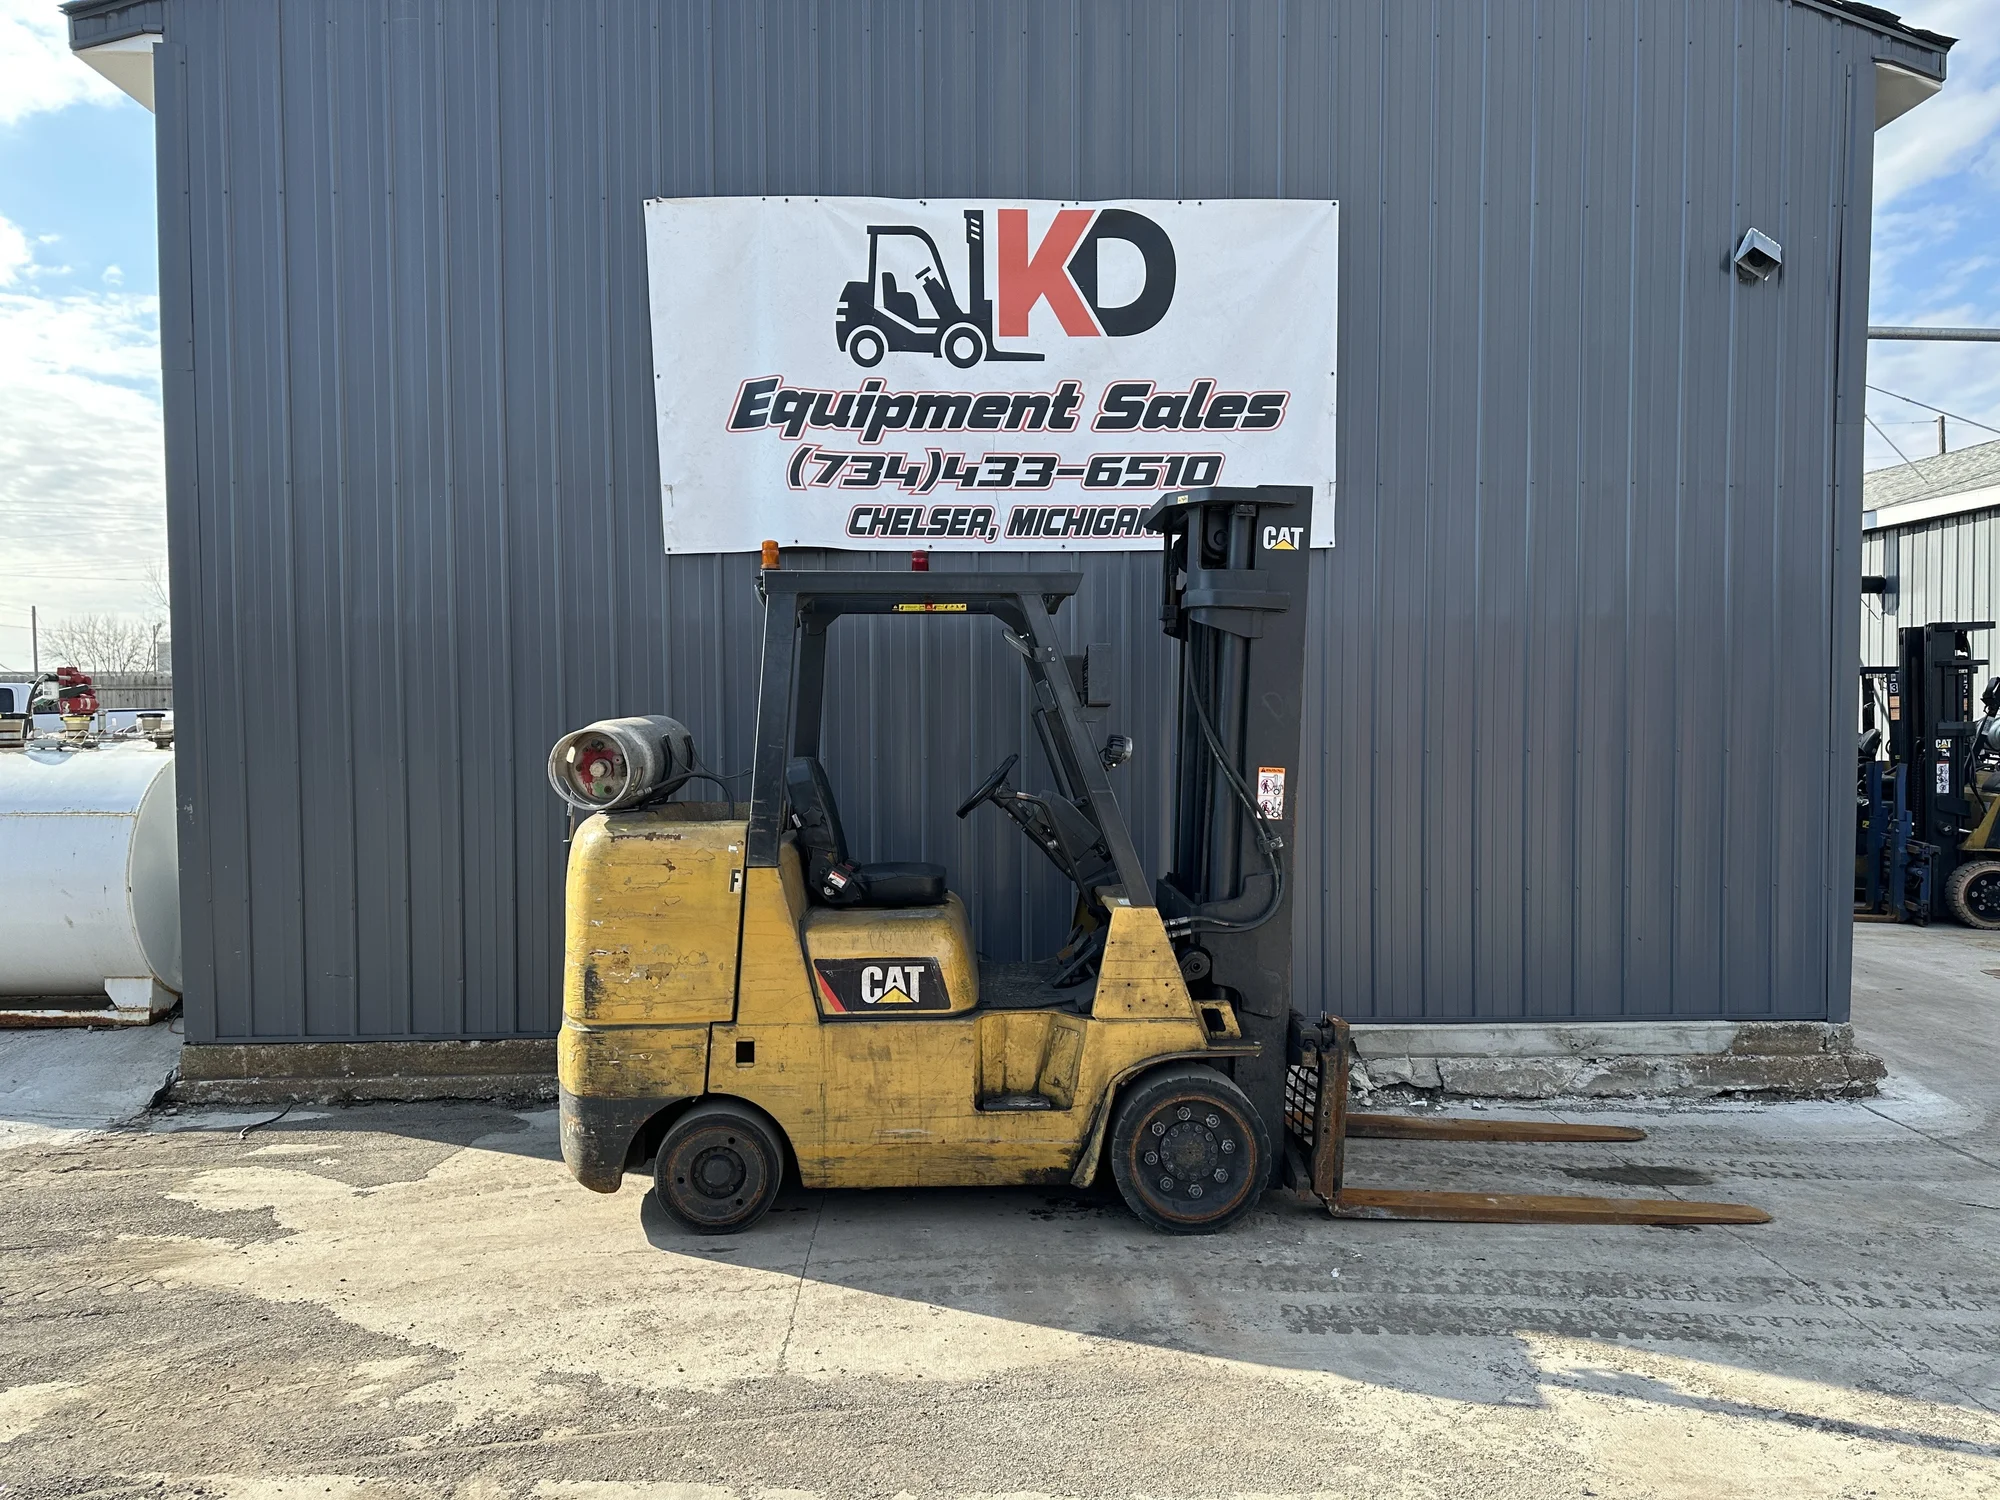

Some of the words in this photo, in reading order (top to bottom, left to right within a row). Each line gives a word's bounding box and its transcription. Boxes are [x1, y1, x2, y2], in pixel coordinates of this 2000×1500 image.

[998, 208, 1177, 337] KD
[730, 378, 1080, 442] Equipment
[1095, 383, 1286, 430] Sales
[789, 447, 1223, 491] (734)433-6510
[848, 507, 997, 541] CHELSEA,
[1262, 526, 1304, 550] CAT
[1935, 739, 1952, 749] CAT
[861, 965, 925, 1004] CAT
